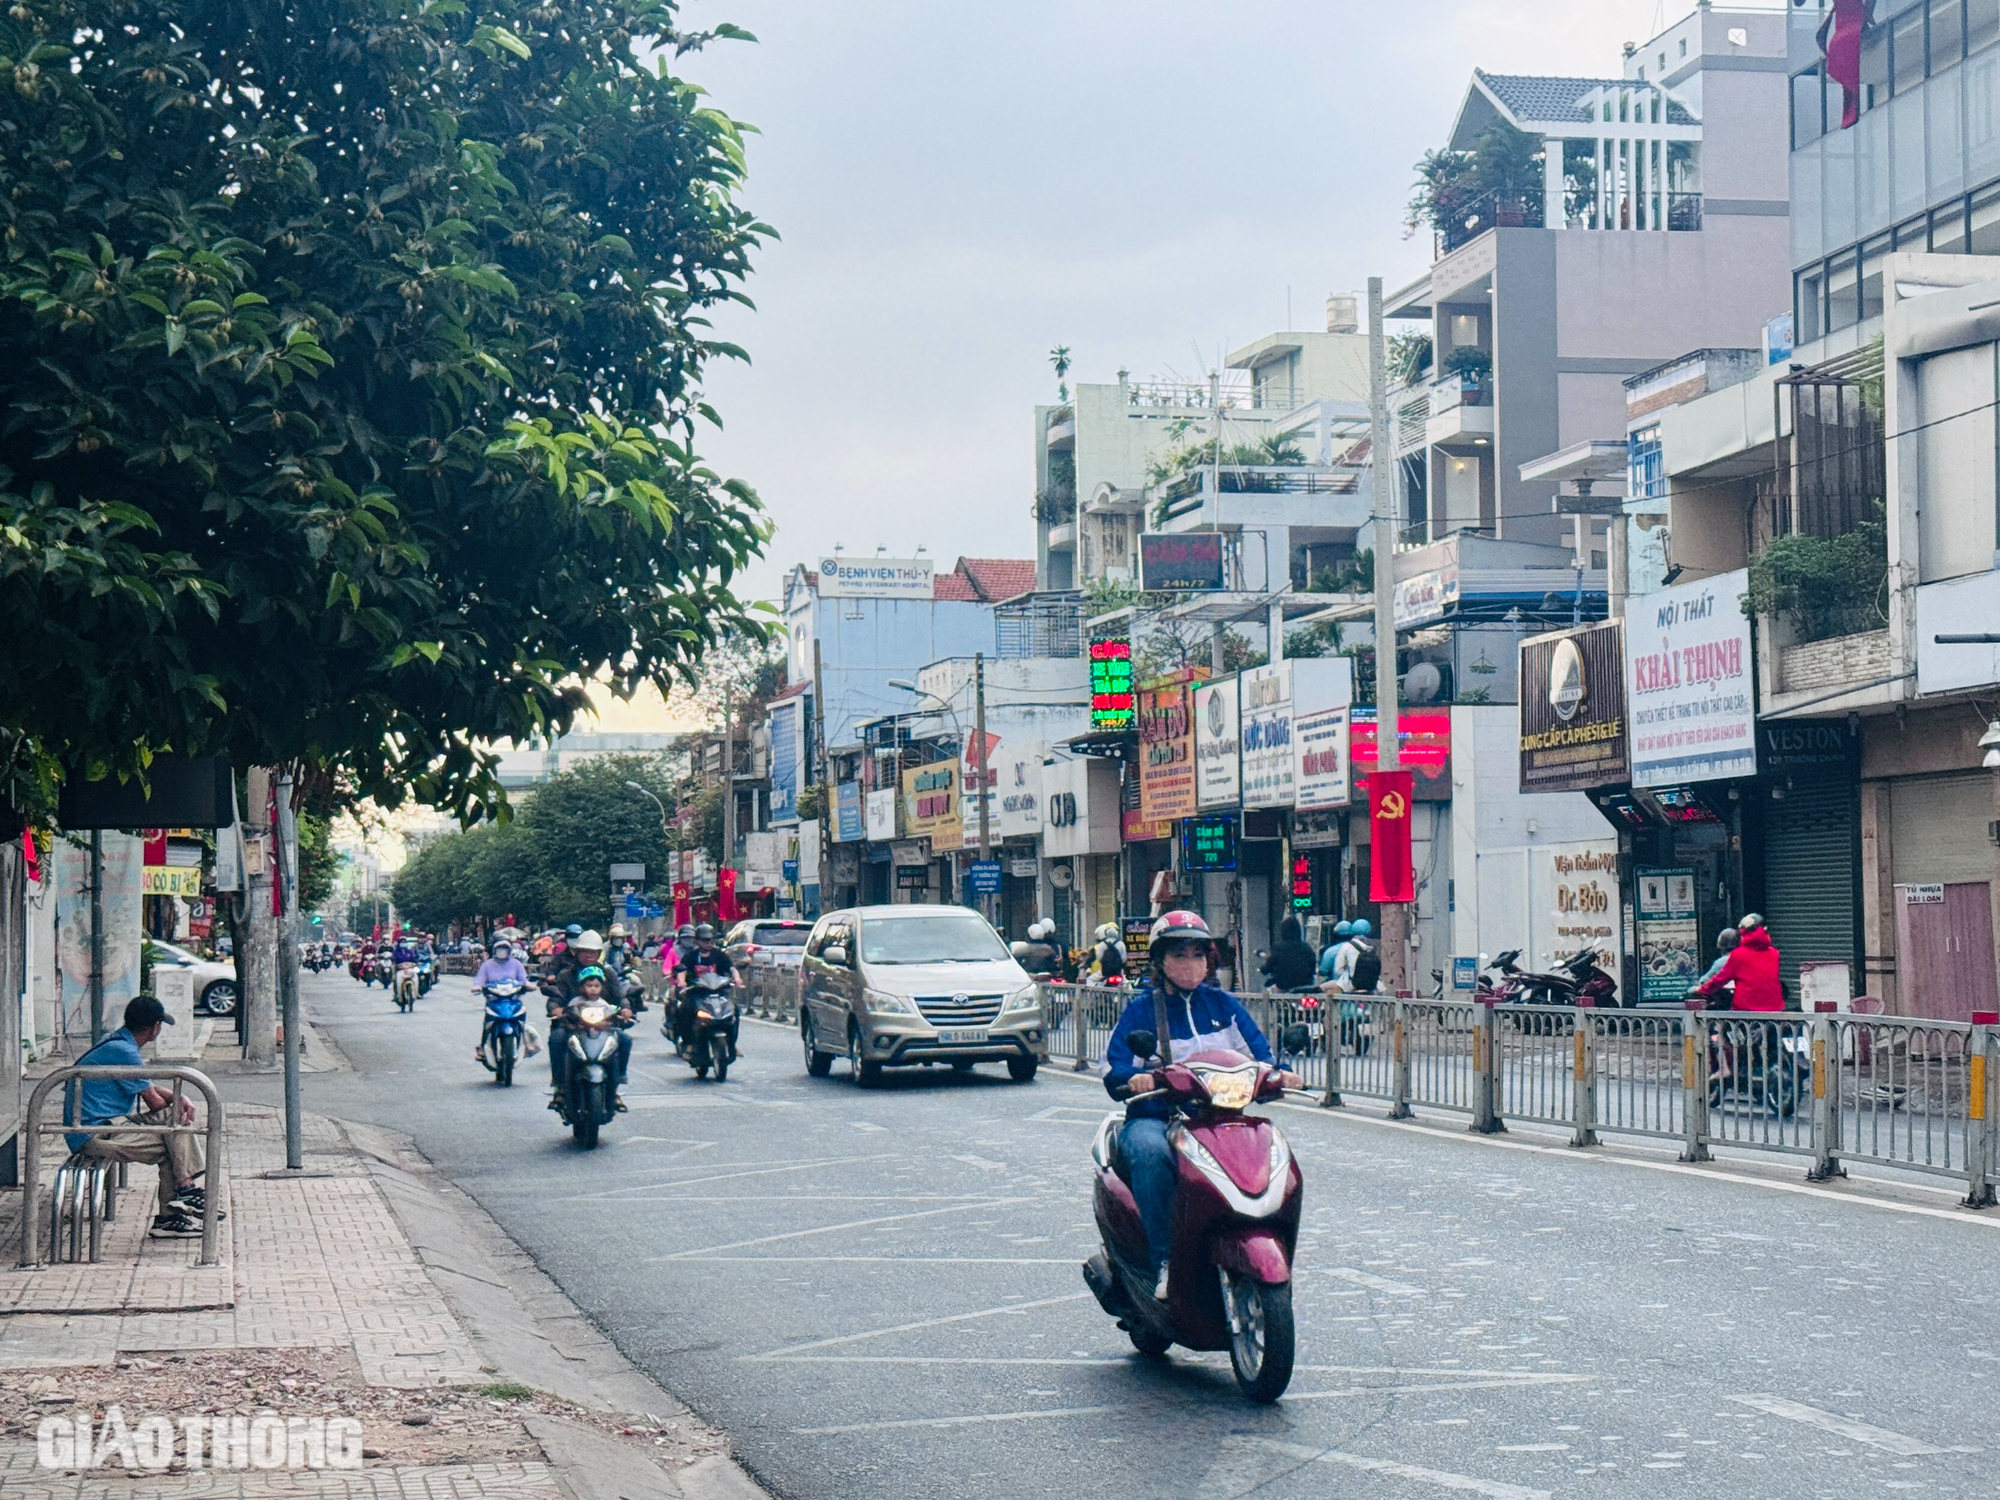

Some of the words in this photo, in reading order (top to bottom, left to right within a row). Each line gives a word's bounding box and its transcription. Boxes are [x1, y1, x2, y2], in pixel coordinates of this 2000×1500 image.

[839, 567, 869, 580] BỆNH
[869, 567, 896, 581] VIỆN
[902, 581, 931, 589] HOSPITAL
[1657, 600, 1679, 630] NỘI
[1684, 588, 1715, 622] THẤT
[1634, 637, 1681, 694] KHẢI
[1684, 637, 1743, 691] THỊNH
[1520, 734, 1543, 751] CUNG
[1543, 723, 1561, 747] CẤP
[1767, 727, 1843, 750] VESTON
[1919, 885, 1942, 893] NHỰA
